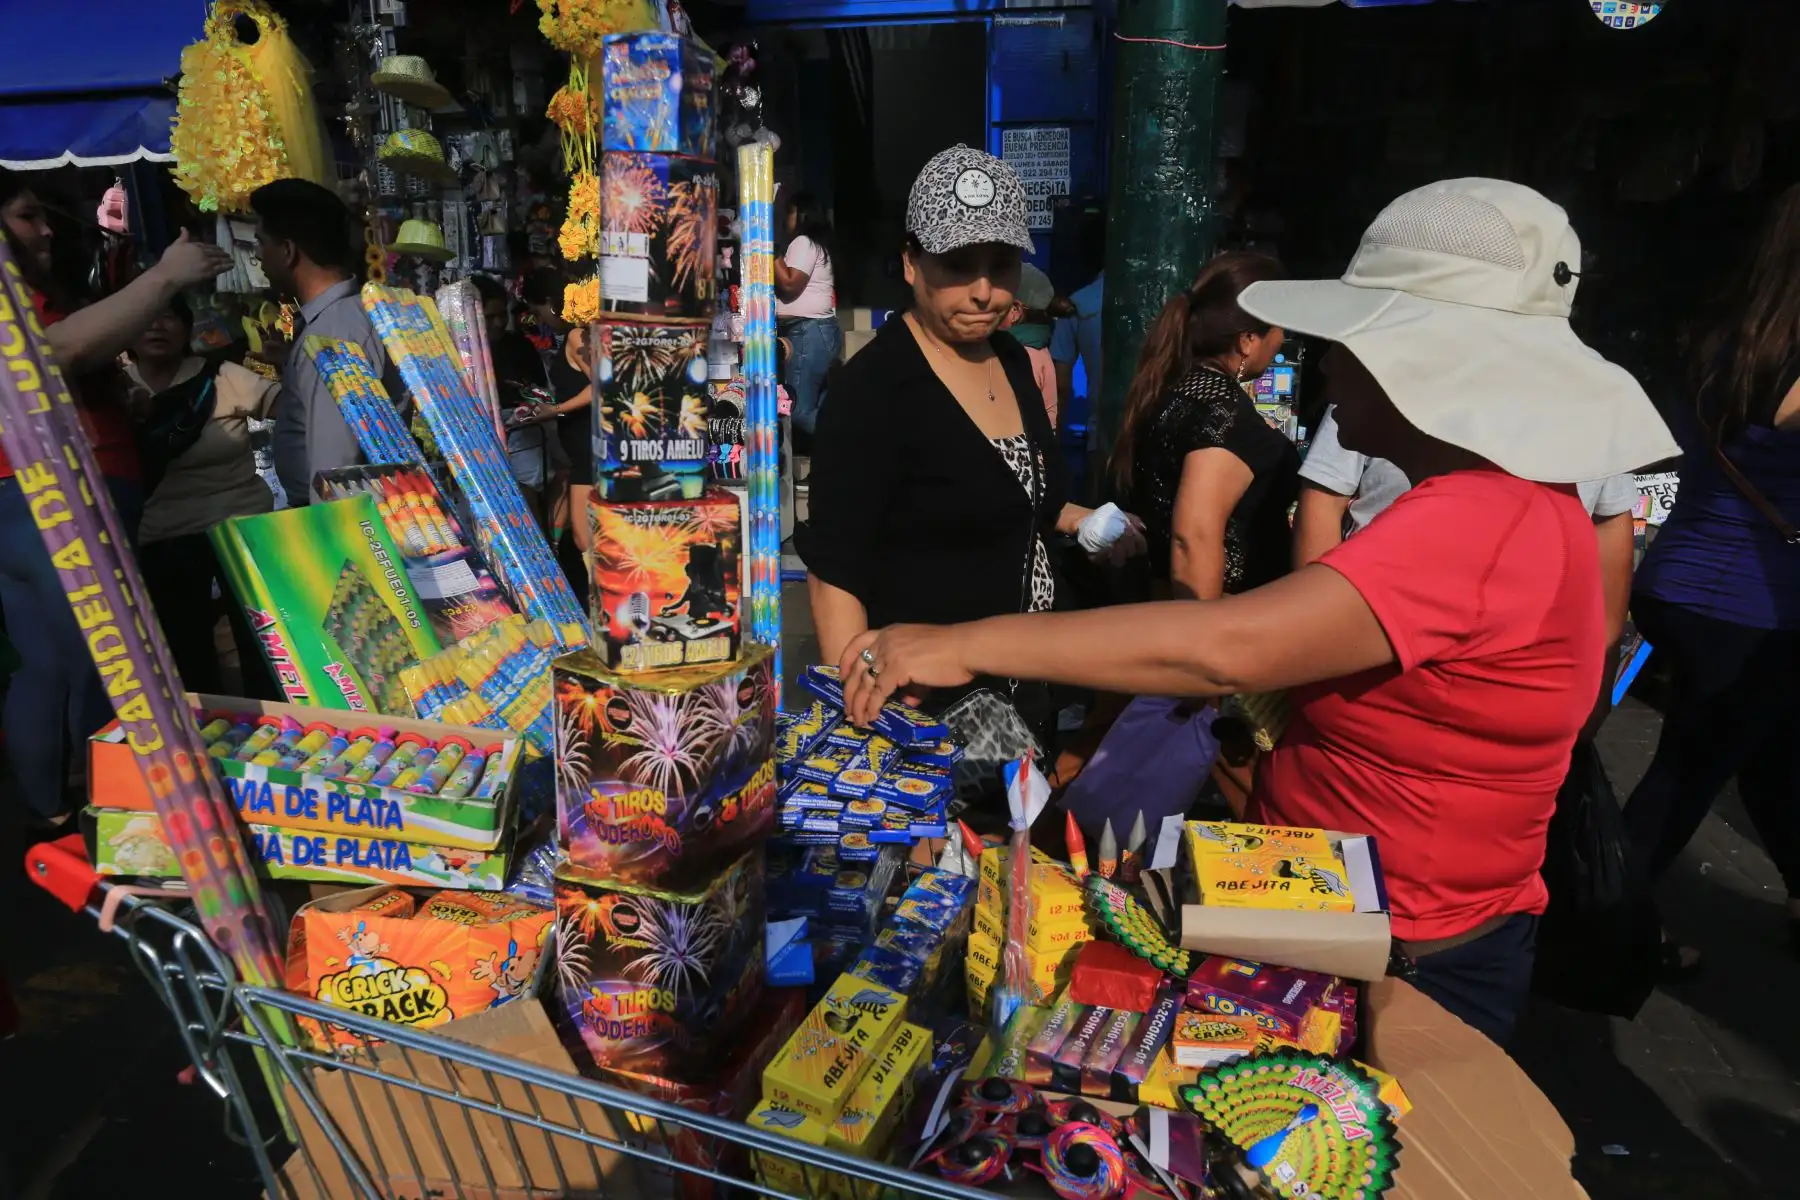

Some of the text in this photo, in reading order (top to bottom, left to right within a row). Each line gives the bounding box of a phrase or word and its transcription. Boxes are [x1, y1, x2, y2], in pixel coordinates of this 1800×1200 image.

[1004, 130, 1069, 142] SE BUSCA VENDEDORA
[1004, 141, 1069, 152] BUENA PRESENCIA
[1023, 169, 1037, 177] 922
[0, 281, 52, 415] LUCE
[620, 441, 628, 461] 9
[630, 440, 664, 460] TIROS
[15, 461, 75, 530] DE
[359, 520, 421, 629] IC-2EFUE01-05
[52, 536, 165, 756] CANDELA
[247, 604, 309, 704] AMEL
[613, 787, 666, 817] TIROS
[740, 758, 775, 812] TIROS
[228, 776, 404, 831] VIA DE PLATA
[1245, 825, 1315, 840] ABEJITA
[293, 835, 328, 867] DE
[335, 837, 414, 871] PLATA
[1215, 879, 1292, 892] ABEJITA
[338, 968, 412, 1003] CRICK
[617, 987, 676, 1016] TIROS
[350, 988, 437, 1021] RACK
[1206, 993, 1237, 1016] 10
[1193, 1026, 1243, 1040] CRACK
[823, 1028, 870, 1089] ABEJITA
[872, 1027, 913, 1085] ABEJITA
[771, 1087, 790, 1101] 12
[1288, 1070, 1373, 1141] AMELITA
